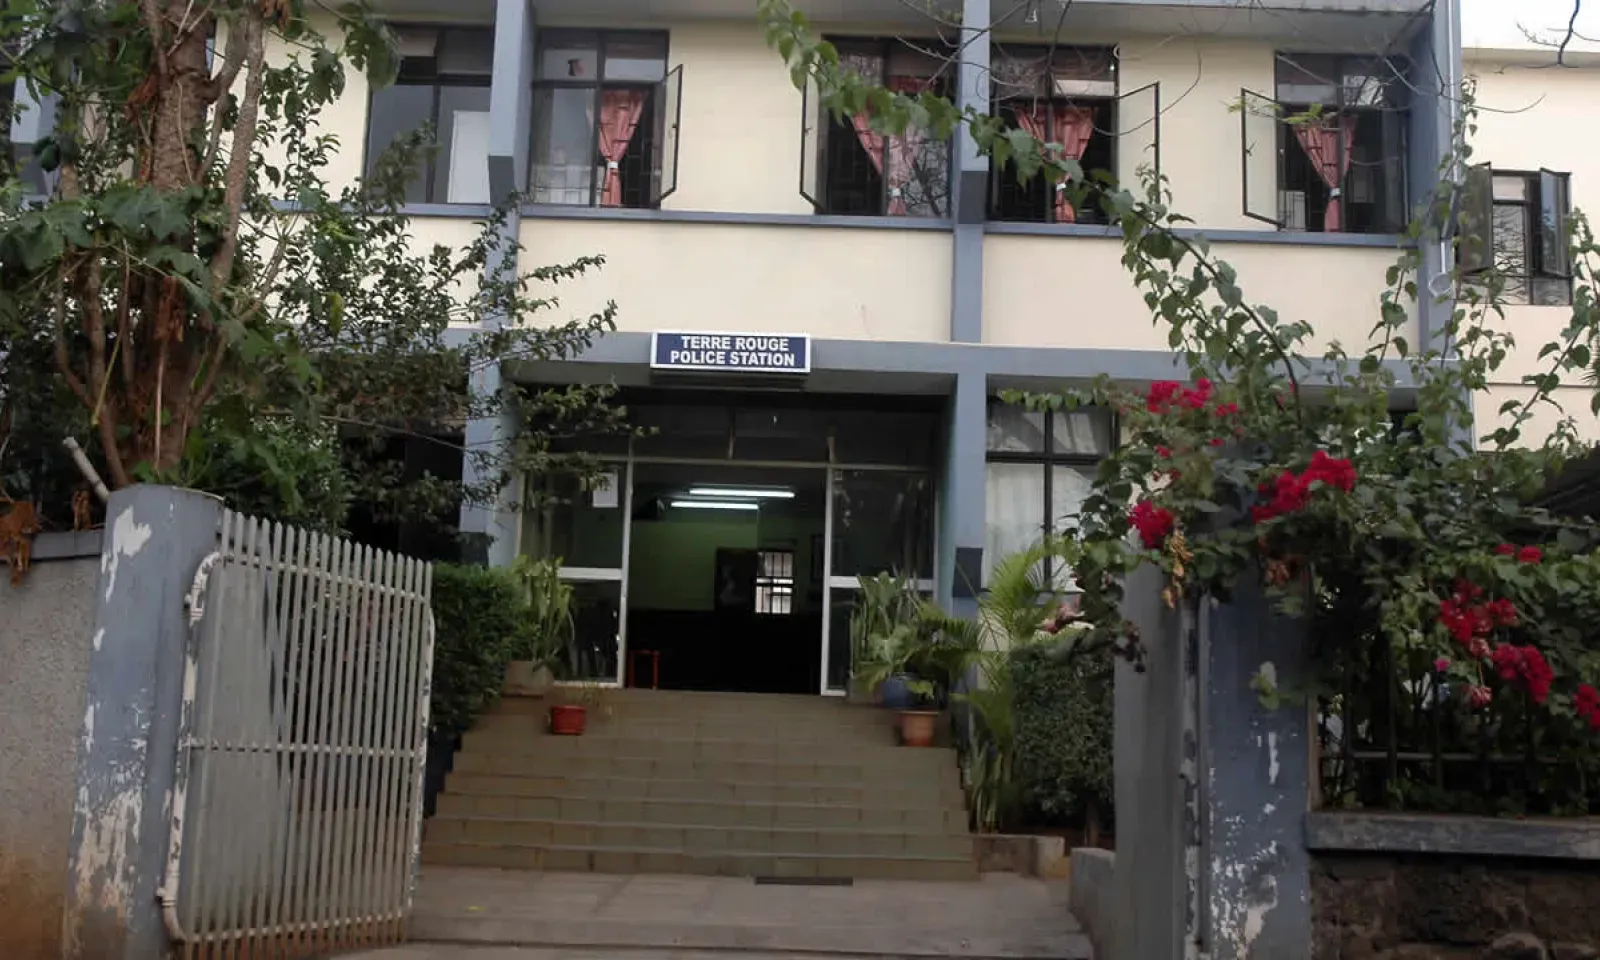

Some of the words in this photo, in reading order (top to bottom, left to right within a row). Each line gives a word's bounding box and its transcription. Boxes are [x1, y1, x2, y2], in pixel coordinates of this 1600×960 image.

[681, 336, 731, 349] TERRE
[735, 337, 789, 351] ROUGE
[670, 350, 726, 364] POLICE
[729, 351, 795, 366] STATION
